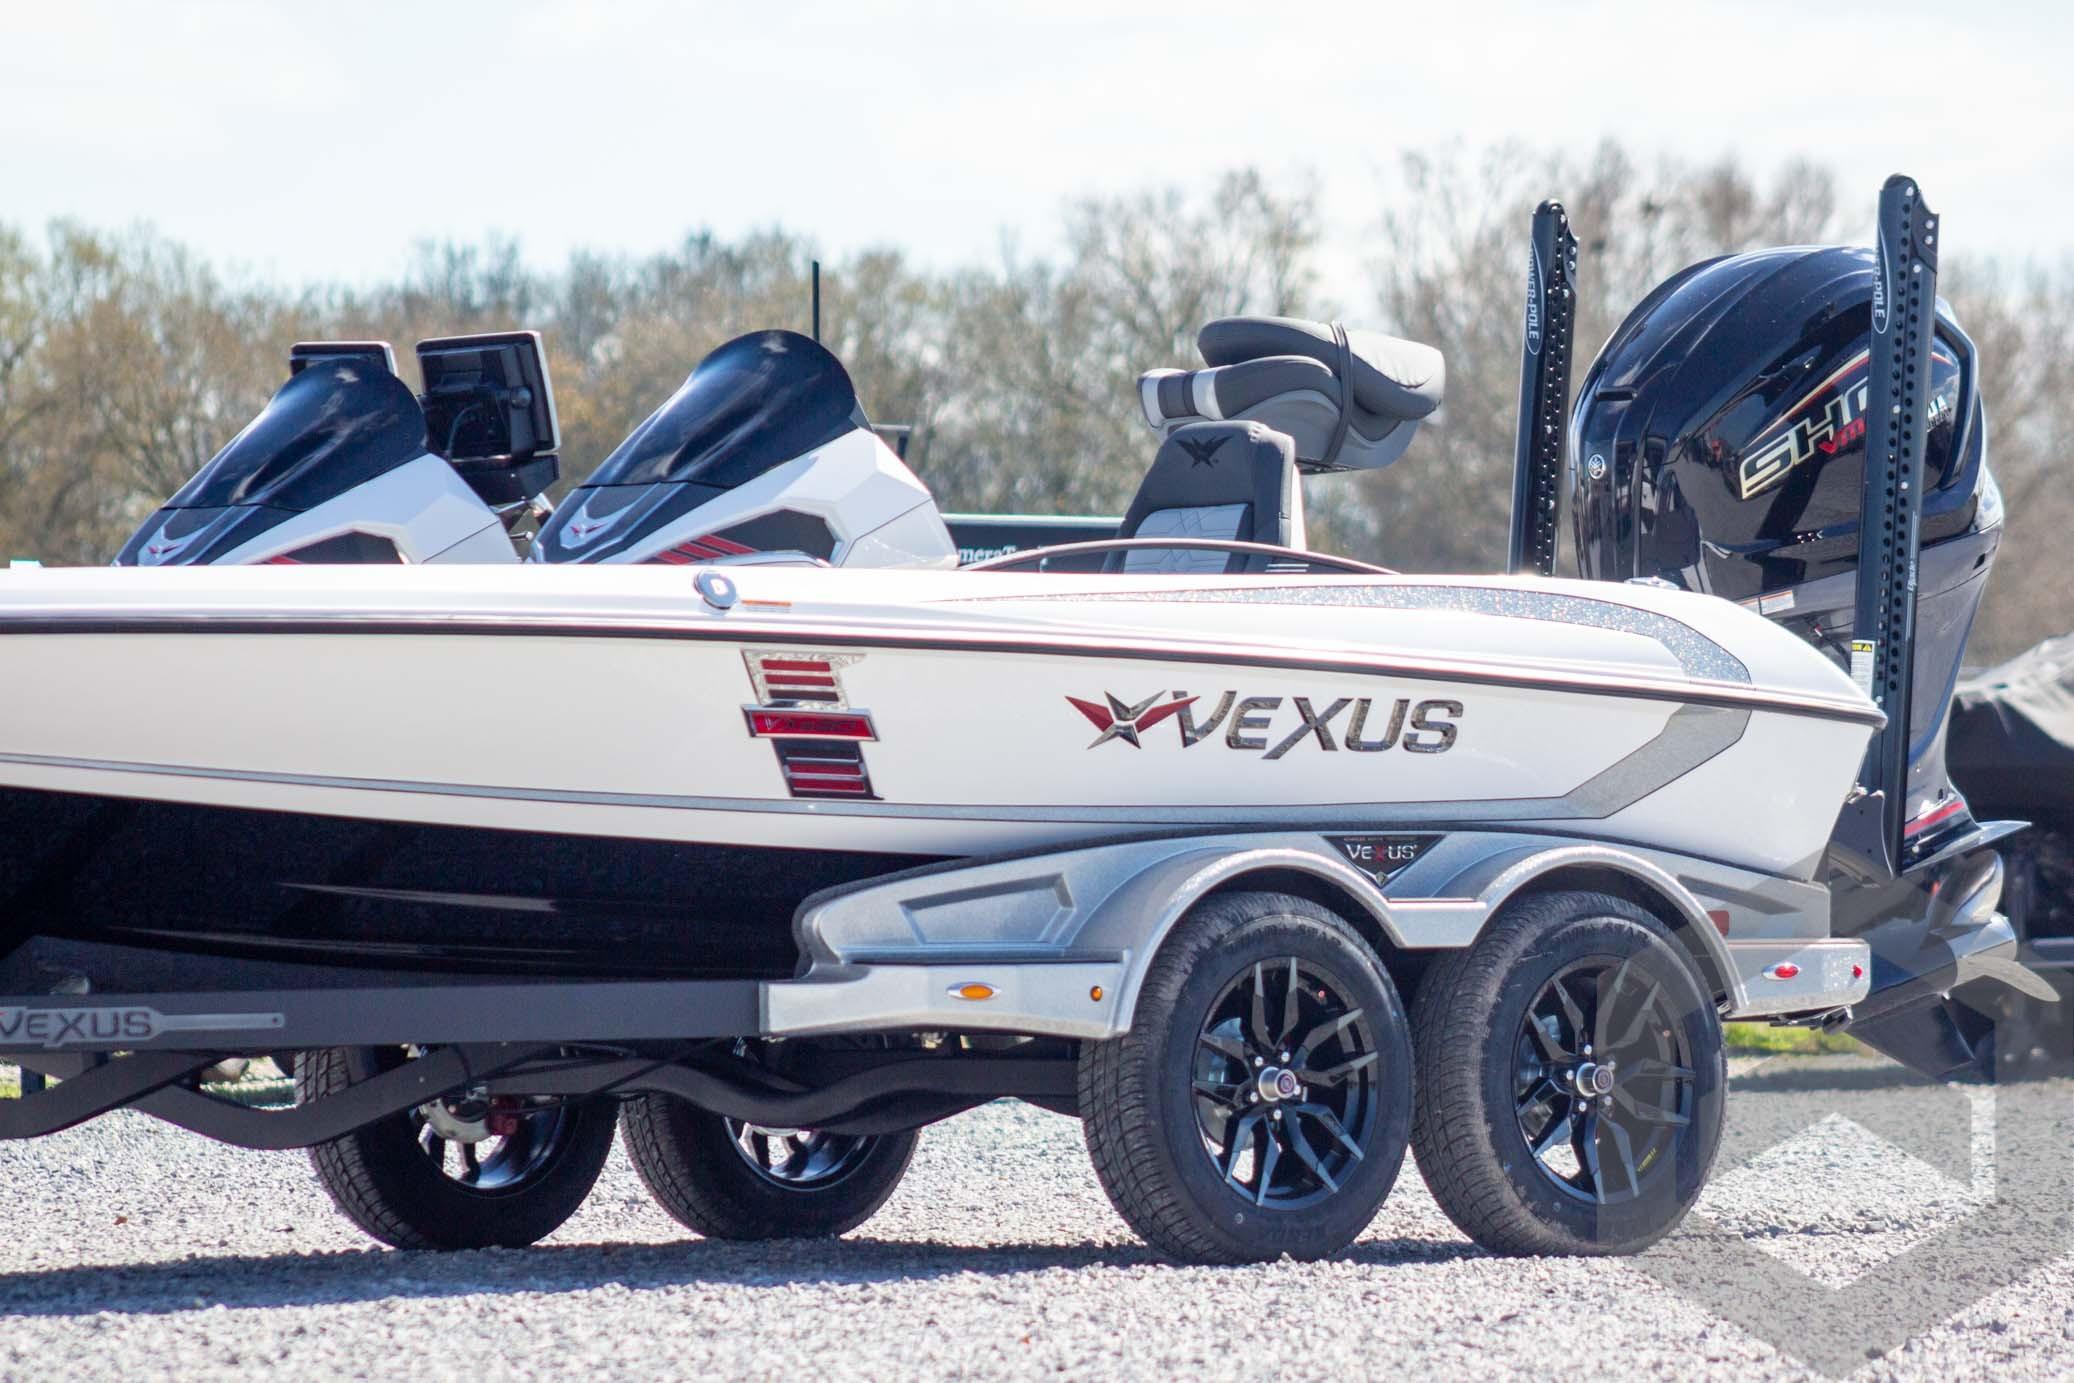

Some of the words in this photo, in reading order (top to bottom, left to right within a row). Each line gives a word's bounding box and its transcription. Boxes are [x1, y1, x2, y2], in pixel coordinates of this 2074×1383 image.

[1172, 690, 1464, 760] VEXUS
[1345, 843, 1415, 862] VEXUS
[0, 1010, 152, 1042] VEXUS
